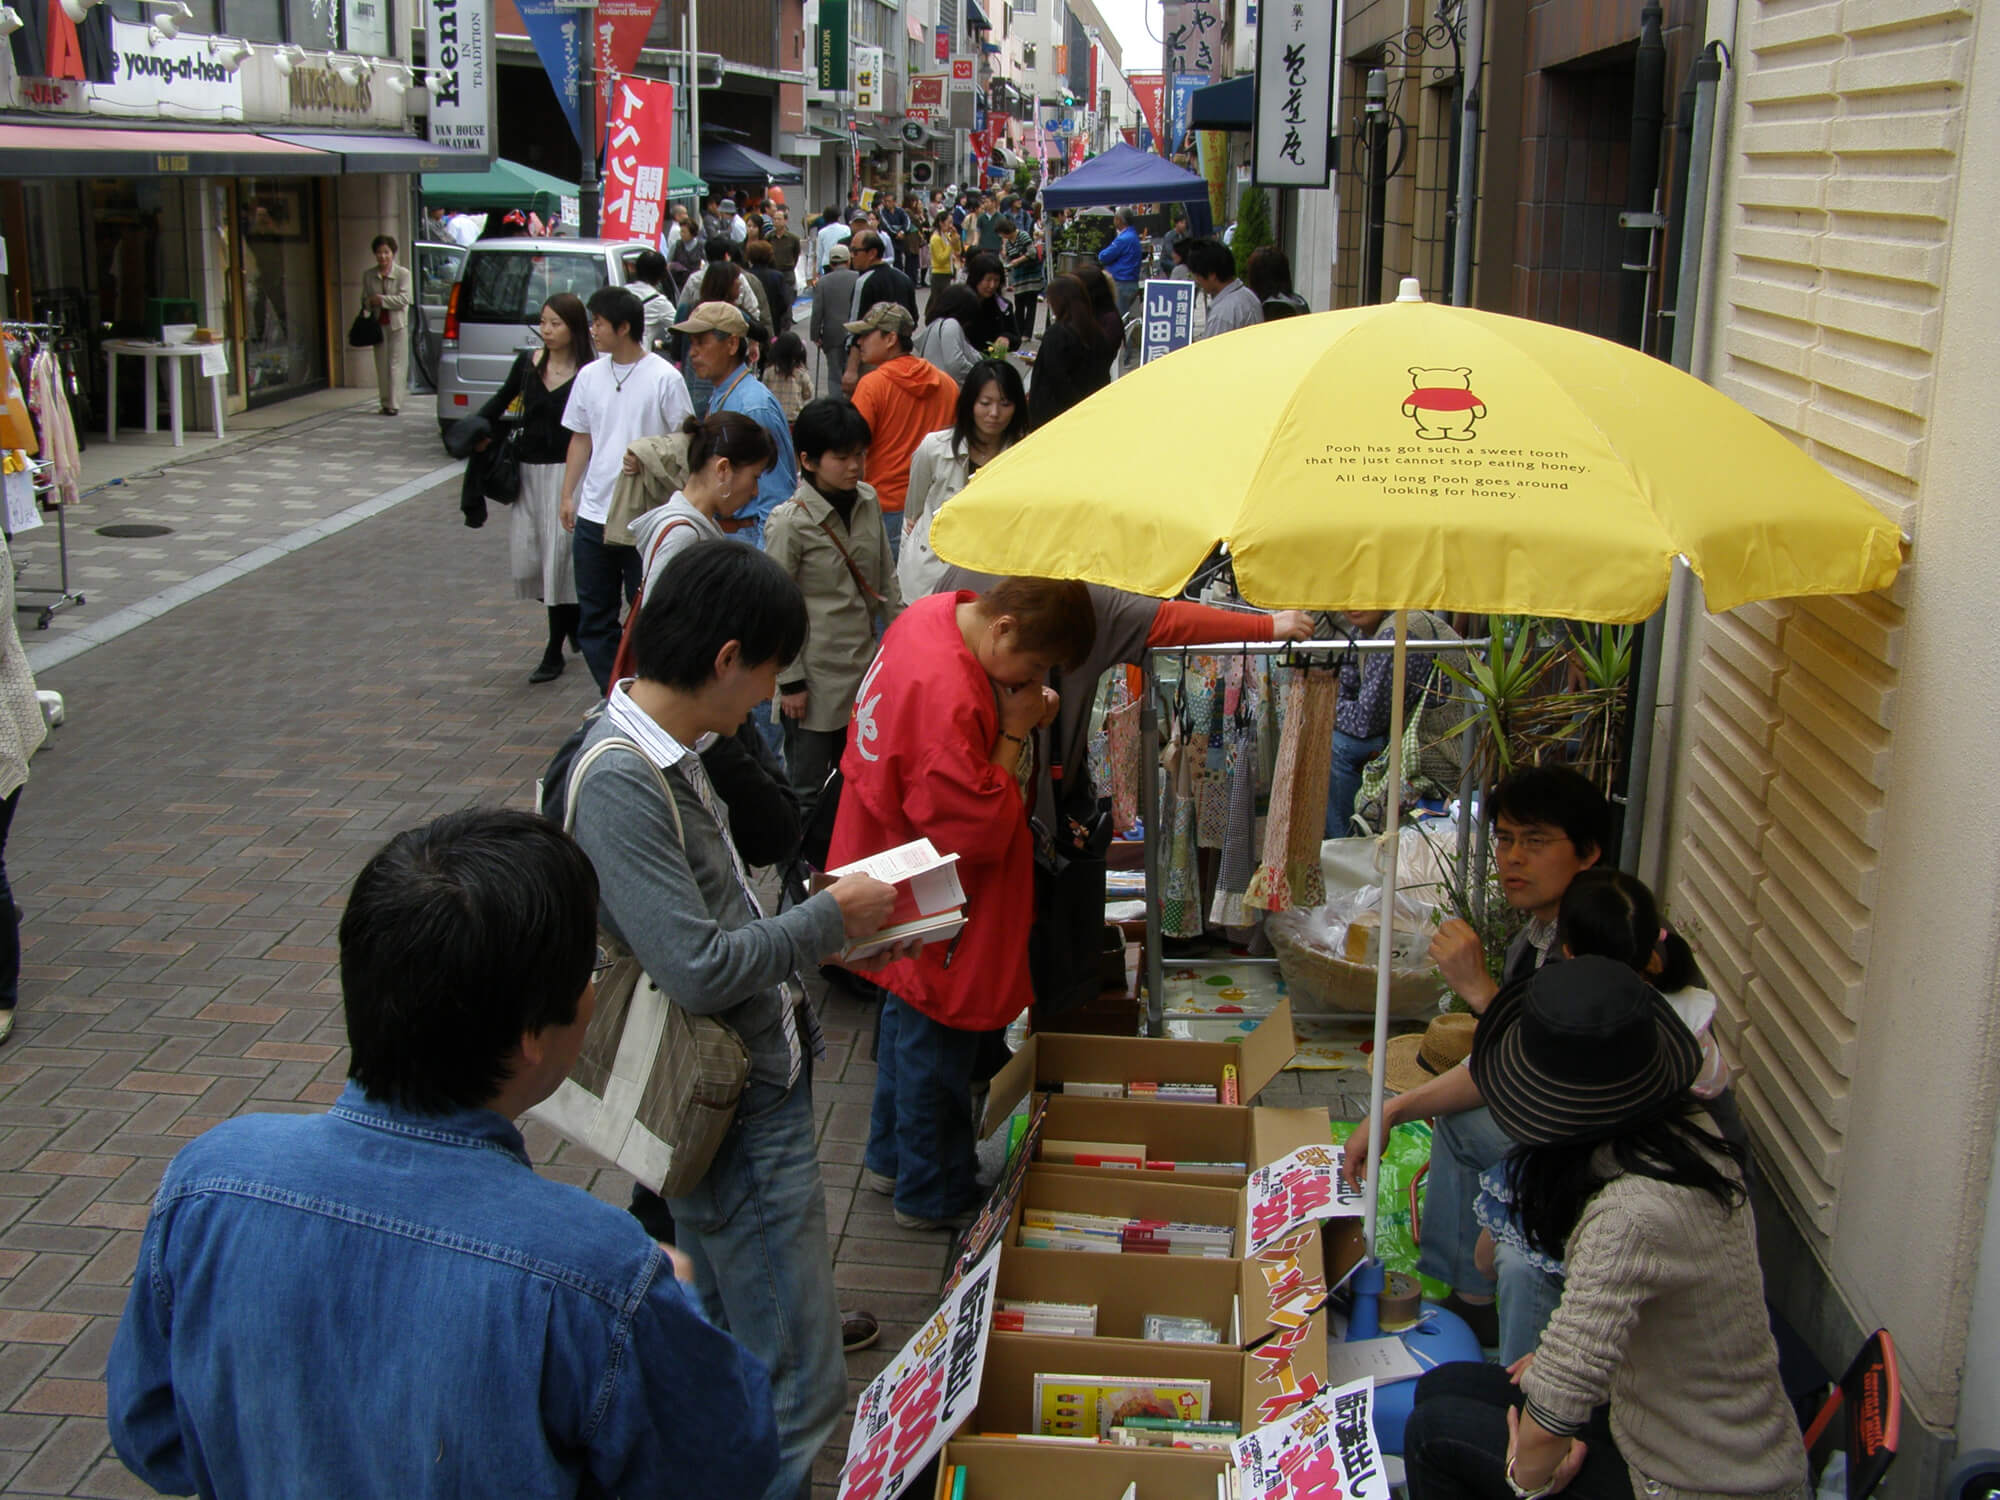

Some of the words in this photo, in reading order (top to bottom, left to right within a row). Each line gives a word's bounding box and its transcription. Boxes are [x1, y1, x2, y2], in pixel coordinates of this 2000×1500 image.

[629, 8, 651, 16] Street
[462, 43, 471, 58] IN
[472, 13, 483, 88] TRADITION
[823, 29, 831, 57] MODE
[823, 60, 831, 87] COCO
[434, 125, 452, 136] VAN
[456, 125, 485, 136] HOUSE
[438, 139, 481, 149] OKAYAMA
[1326, 444, 1360, 453] Pooh
[1368, 445, 1391, 453] has
[1398, 446, 1422, 455] got
[1428, 446, 1459, 454] such
[1480, 449, 1522, 457] sweet
[1530, 450, 1568, 459] tooth
[1306, 456, 1333, 465] that
[1340, 456, 1356, 464] he
[1362, 456, 1388, 465] just
[1395, 457, 1444, 465] cannot
[1451, 458, 1482, 468] stop
[1489, 459, 1535, 471] eating
[1541, 461, 1591, 474] honey.
[1336, 474, 1355, 483] All
[1362, 474, 1387, 484] day
[1394, 474, 1426, 485] long
[1433, 475, 1468, 484] Pooh
[1475, 478, 1510, 489] goes
[1517, 480, 1568, 491] around
[1383, 486, 1439, 497] looking
[1445, 487, 1464, 496] for
[1472, 488, 1521, 499] honey.
